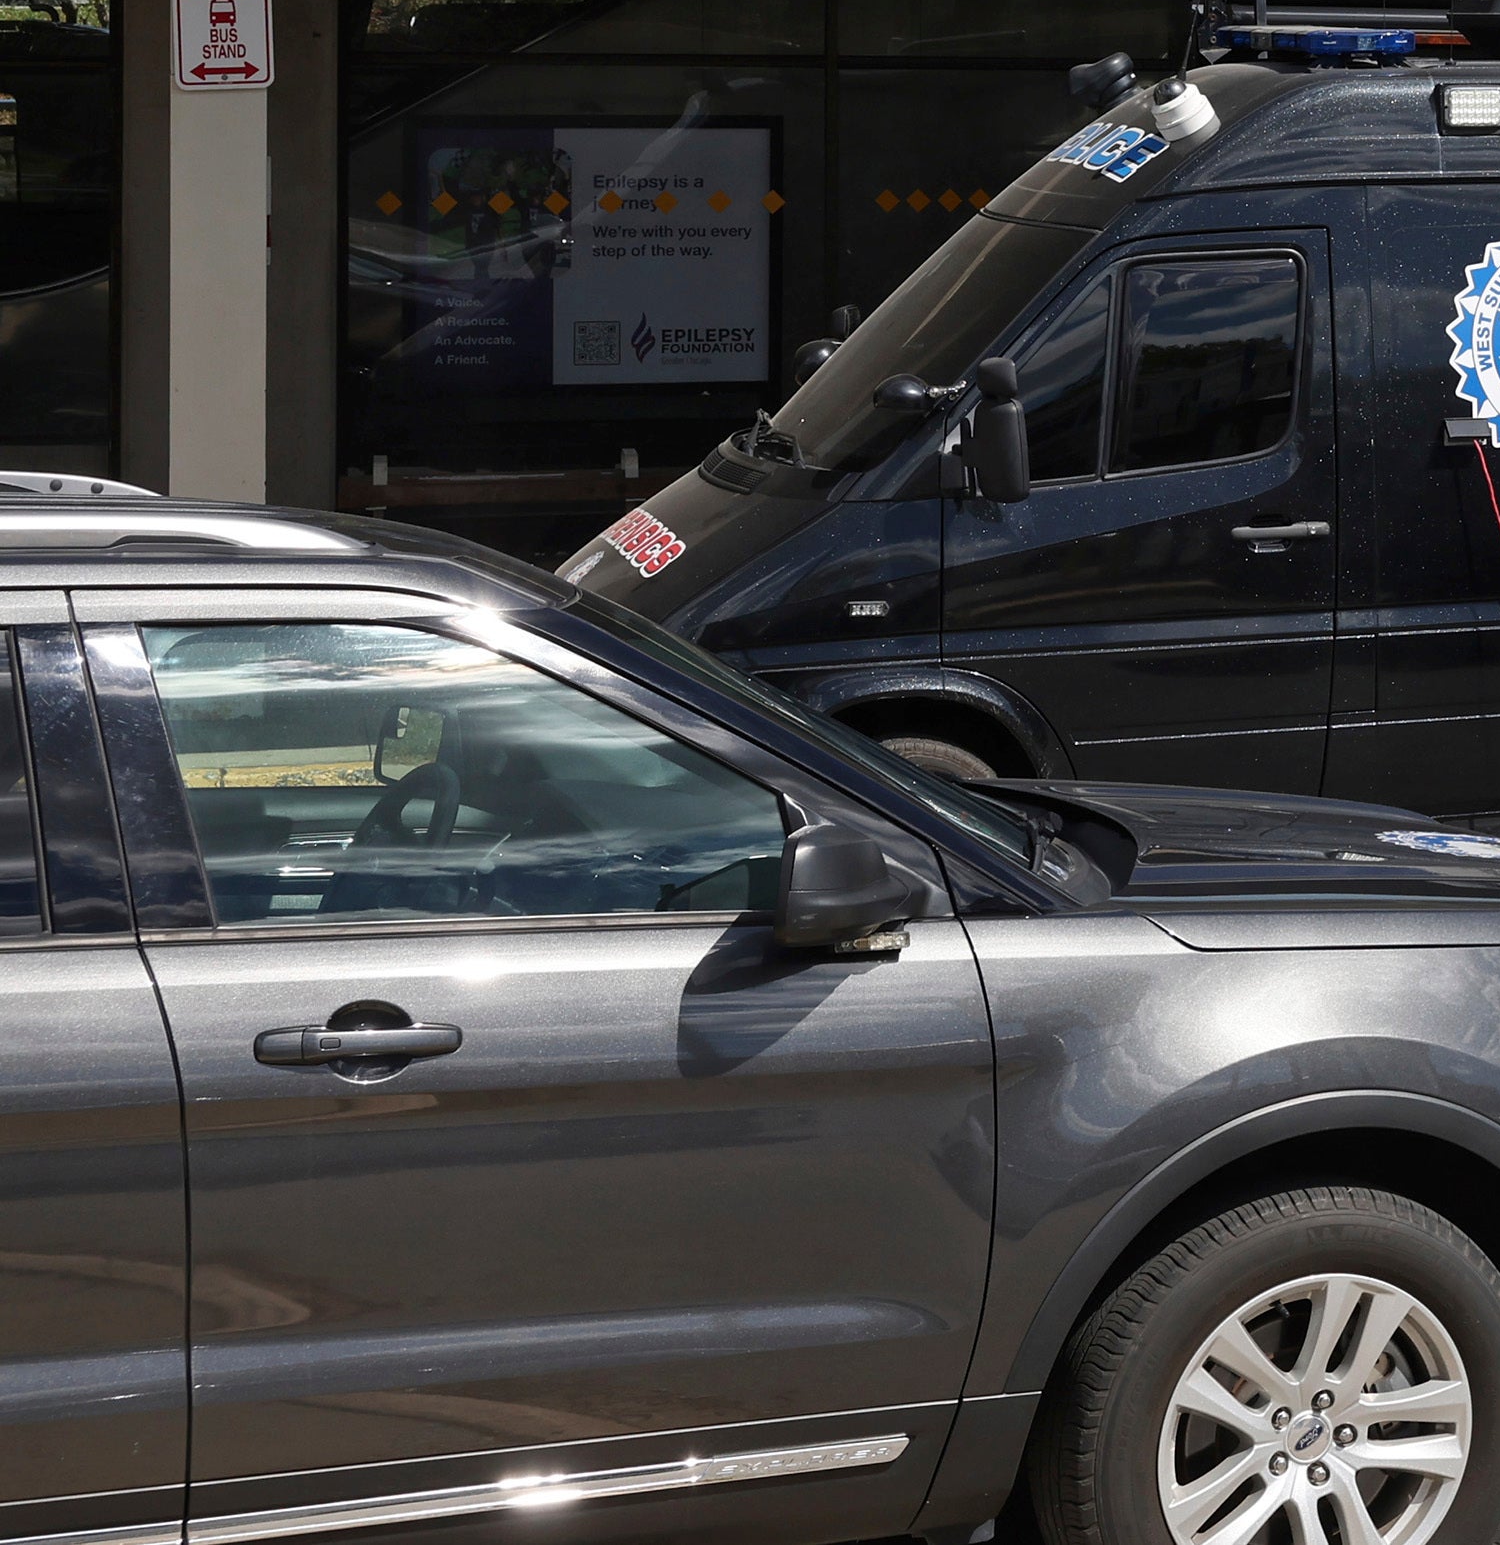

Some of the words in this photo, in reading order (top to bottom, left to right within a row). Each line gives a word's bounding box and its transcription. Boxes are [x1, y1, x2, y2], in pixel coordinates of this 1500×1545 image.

[210, 28, 238, 43] BUS
[202, 44, 246, 59] STAND
[1046, 122, 1170, 184] OLICE
[593, 175, 668, 191] Epilepsy
[674, 174, 688, 188] is
[694, 177, 704, 188] a
[593, 196, 658, 212] jrney
[592, 226, 637, 238] We're
[642, 225, 673, 238] with
[679, 228, 706, 240] you
[711, 227, 752, 240] every
[592, 245, 626, 259] step
[631, 244, 646, 257] of
[651, 244, 675, 257] the
[680, 247, 712, 259] way.
[435, 297, 444, 307] A
[434, 317, 444, 327] A
[448, 316, 509, 327] Resource.
[434, 335, 451, 345] An
[455, 335, 516, 345] Advocate.
[661, 328, 755, 342] EPILEPSY
[1476, 313, 1493, 371] WEST
[661, 342, 755, 353] FOUNDATION
[434, 355, 444, 365] A
[447, 354, 489, 365] Friend.
